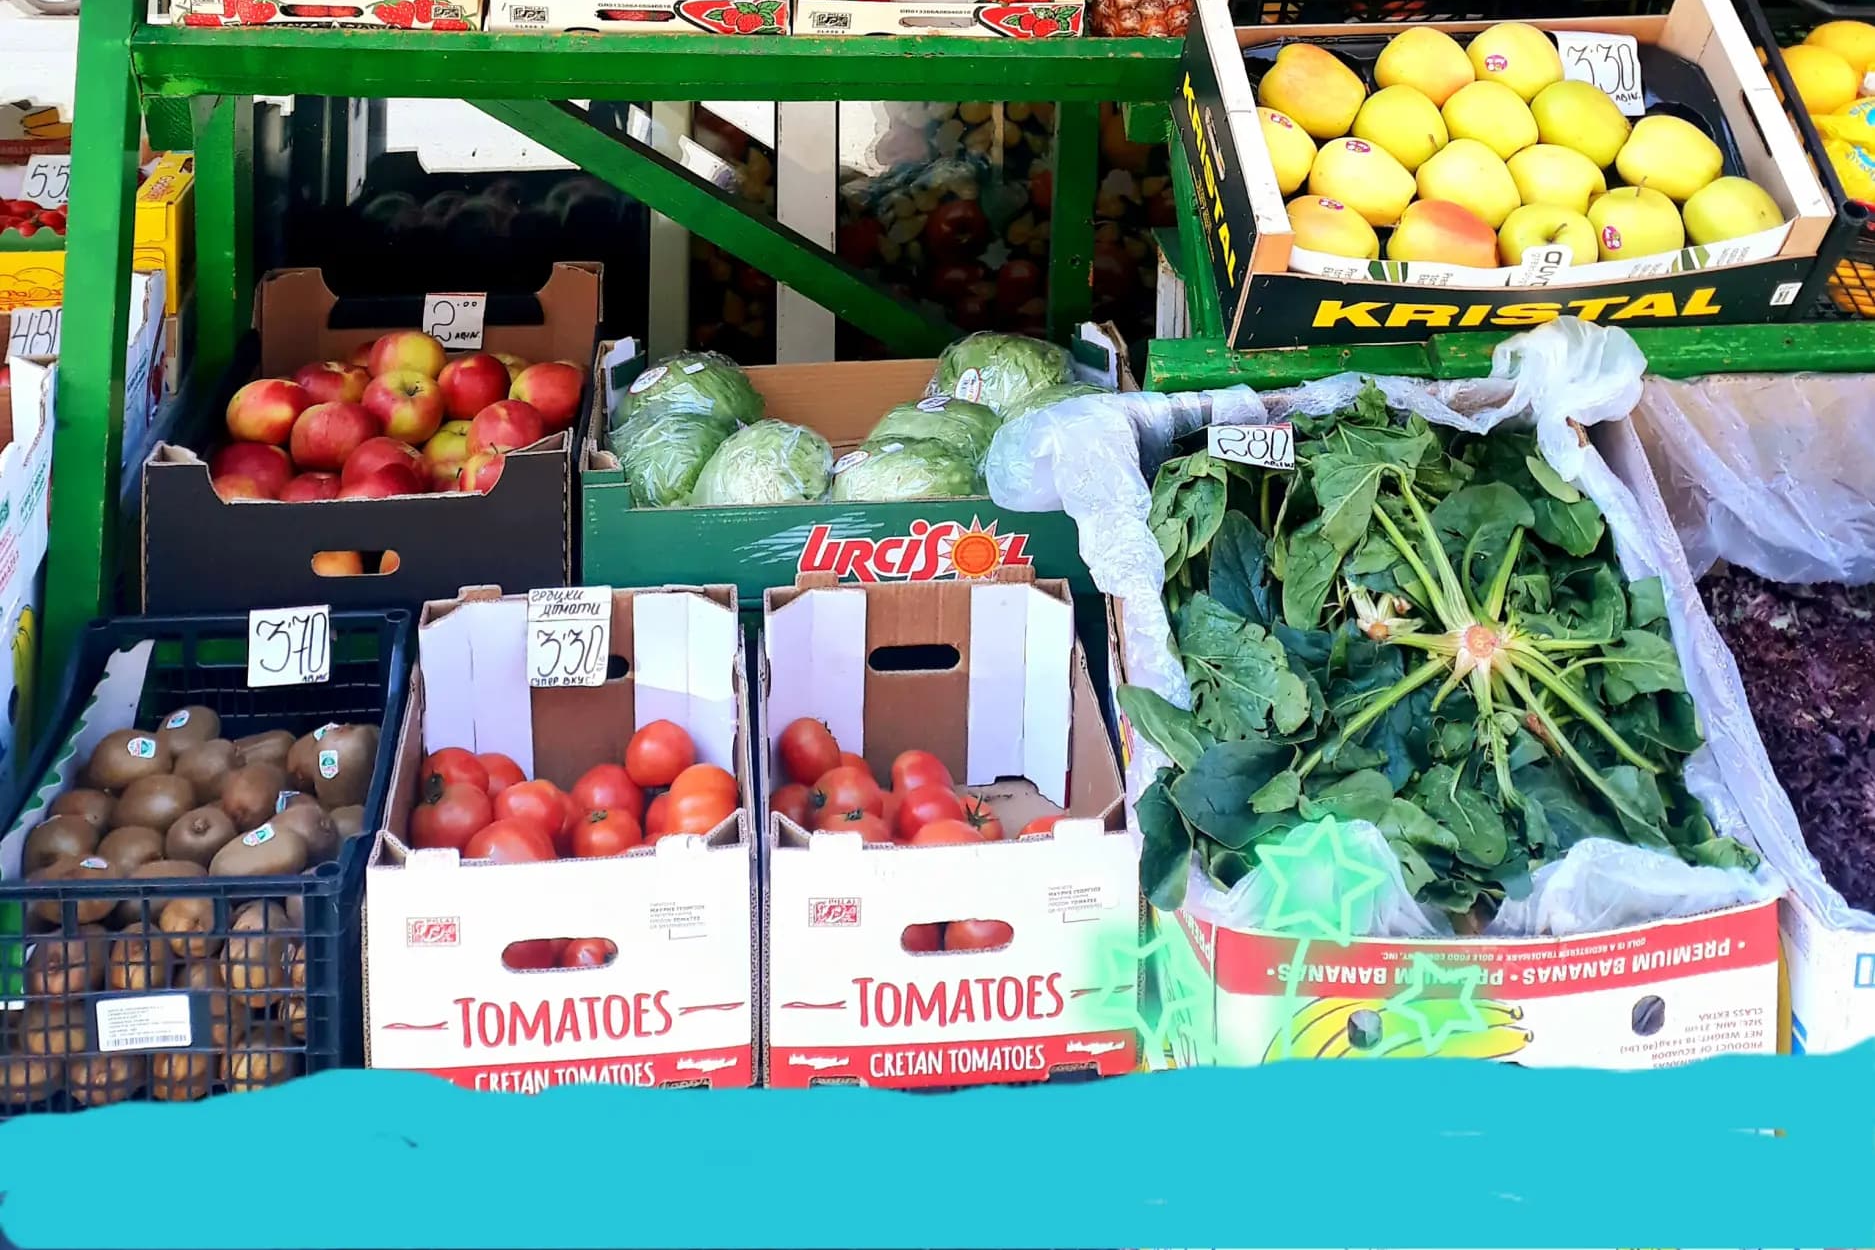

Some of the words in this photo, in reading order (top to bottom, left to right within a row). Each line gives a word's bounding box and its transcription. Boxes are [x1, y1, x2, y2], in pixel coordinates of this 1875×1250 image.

[1184, 72, 1236, 289] KRISTAL
[1311, 288, 1723, 328] KRISTAL
[1522, 956, 1627, 985] BANANAS
[1633, 939, 1730, 972] PREMIUM
[852, 972, 1062, 1029] TOMATOES
[1698, 1011, 1730, 1022] EXTRA
[1732, 1007, 1763, 1017] CLASS
[454, 989, 673, 1049] TOMATOES
[869, 1051, 943, 1079] CRETAN
[948, 1044, 1045, 1073] TOMATOES
[1651, 1047, 1696, 1061] ECUADOR
[1715, 1041, 1763, 1052] PRODUCT
